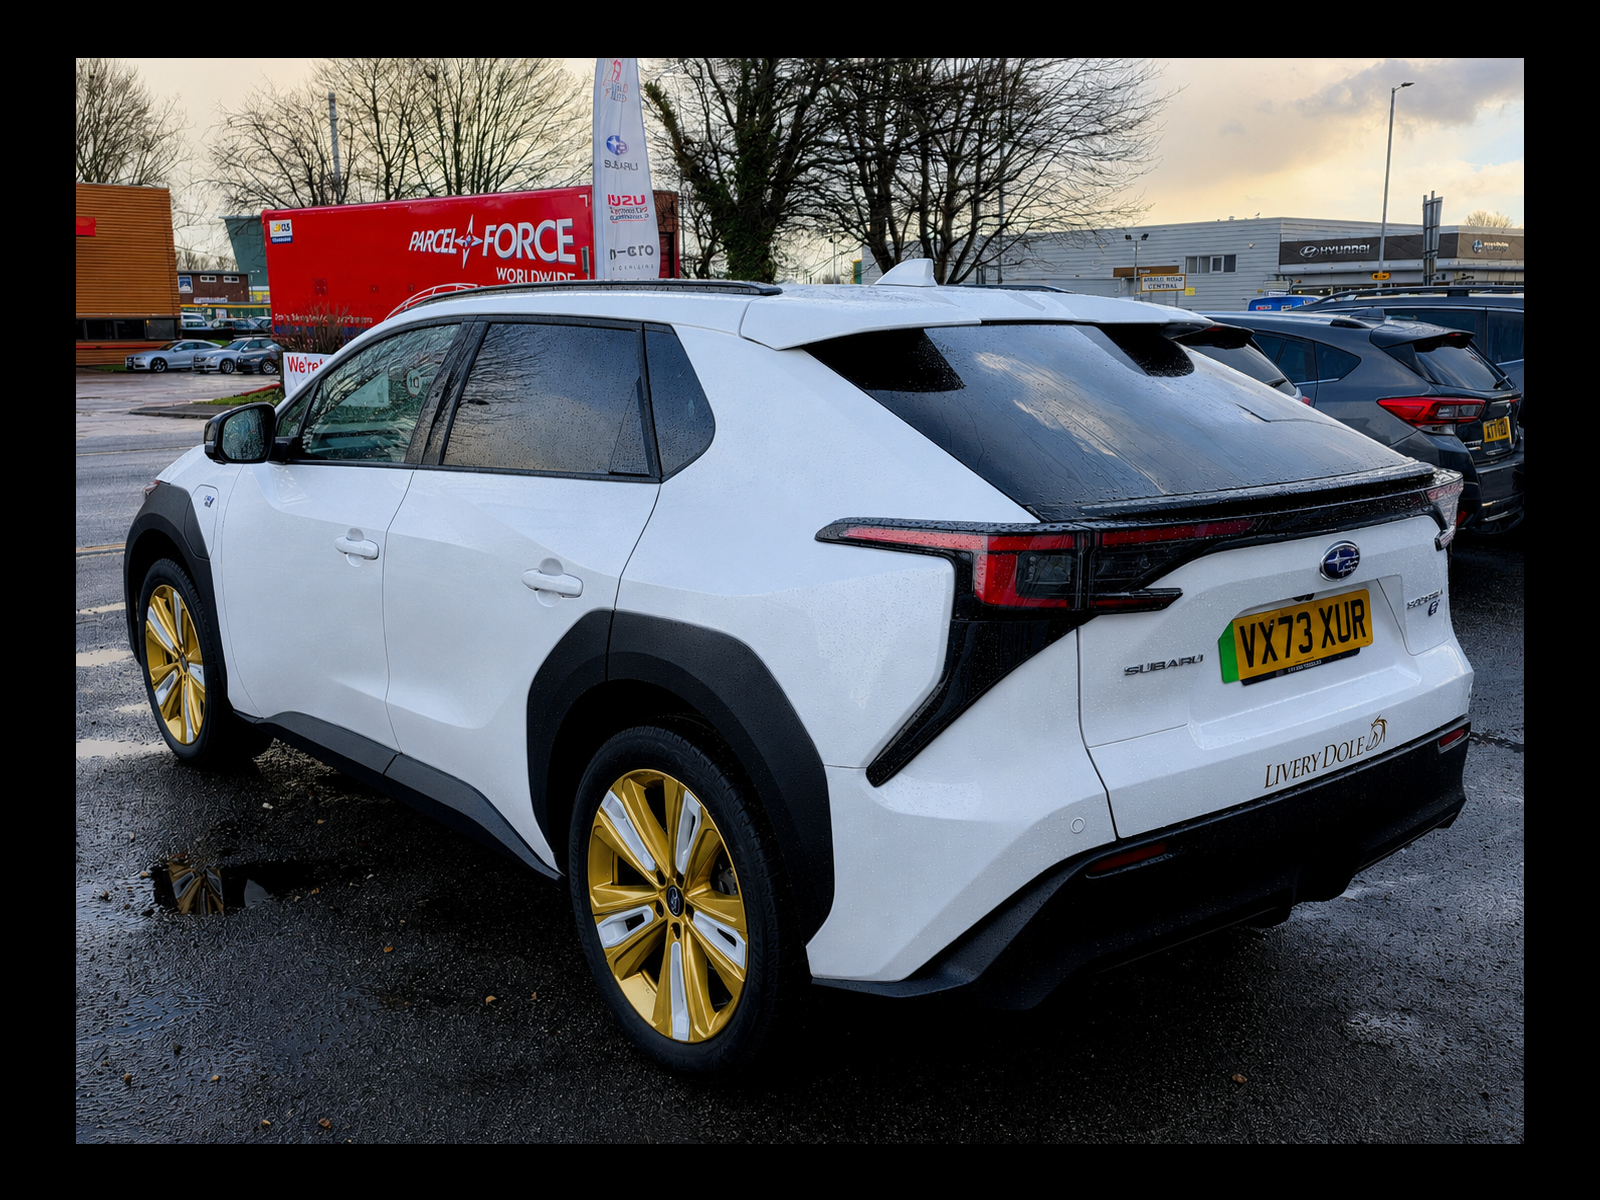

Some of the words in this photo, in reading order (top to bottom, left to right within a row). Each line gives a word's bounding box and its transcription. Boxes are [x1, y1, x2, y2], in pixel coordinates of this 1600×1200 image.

[408, 228, 457, 254] PARCEL
[482, 218, 577, 265] FORCE
[1239, 611, 1313, 668] VX73
[1318, 598, 1367, 649] XUR
[1124, 653, 1204, 676] SUBARU
[1264, 751, 1322, 789] LIVERY
[1322, 736, 1365, 769] DOLE
